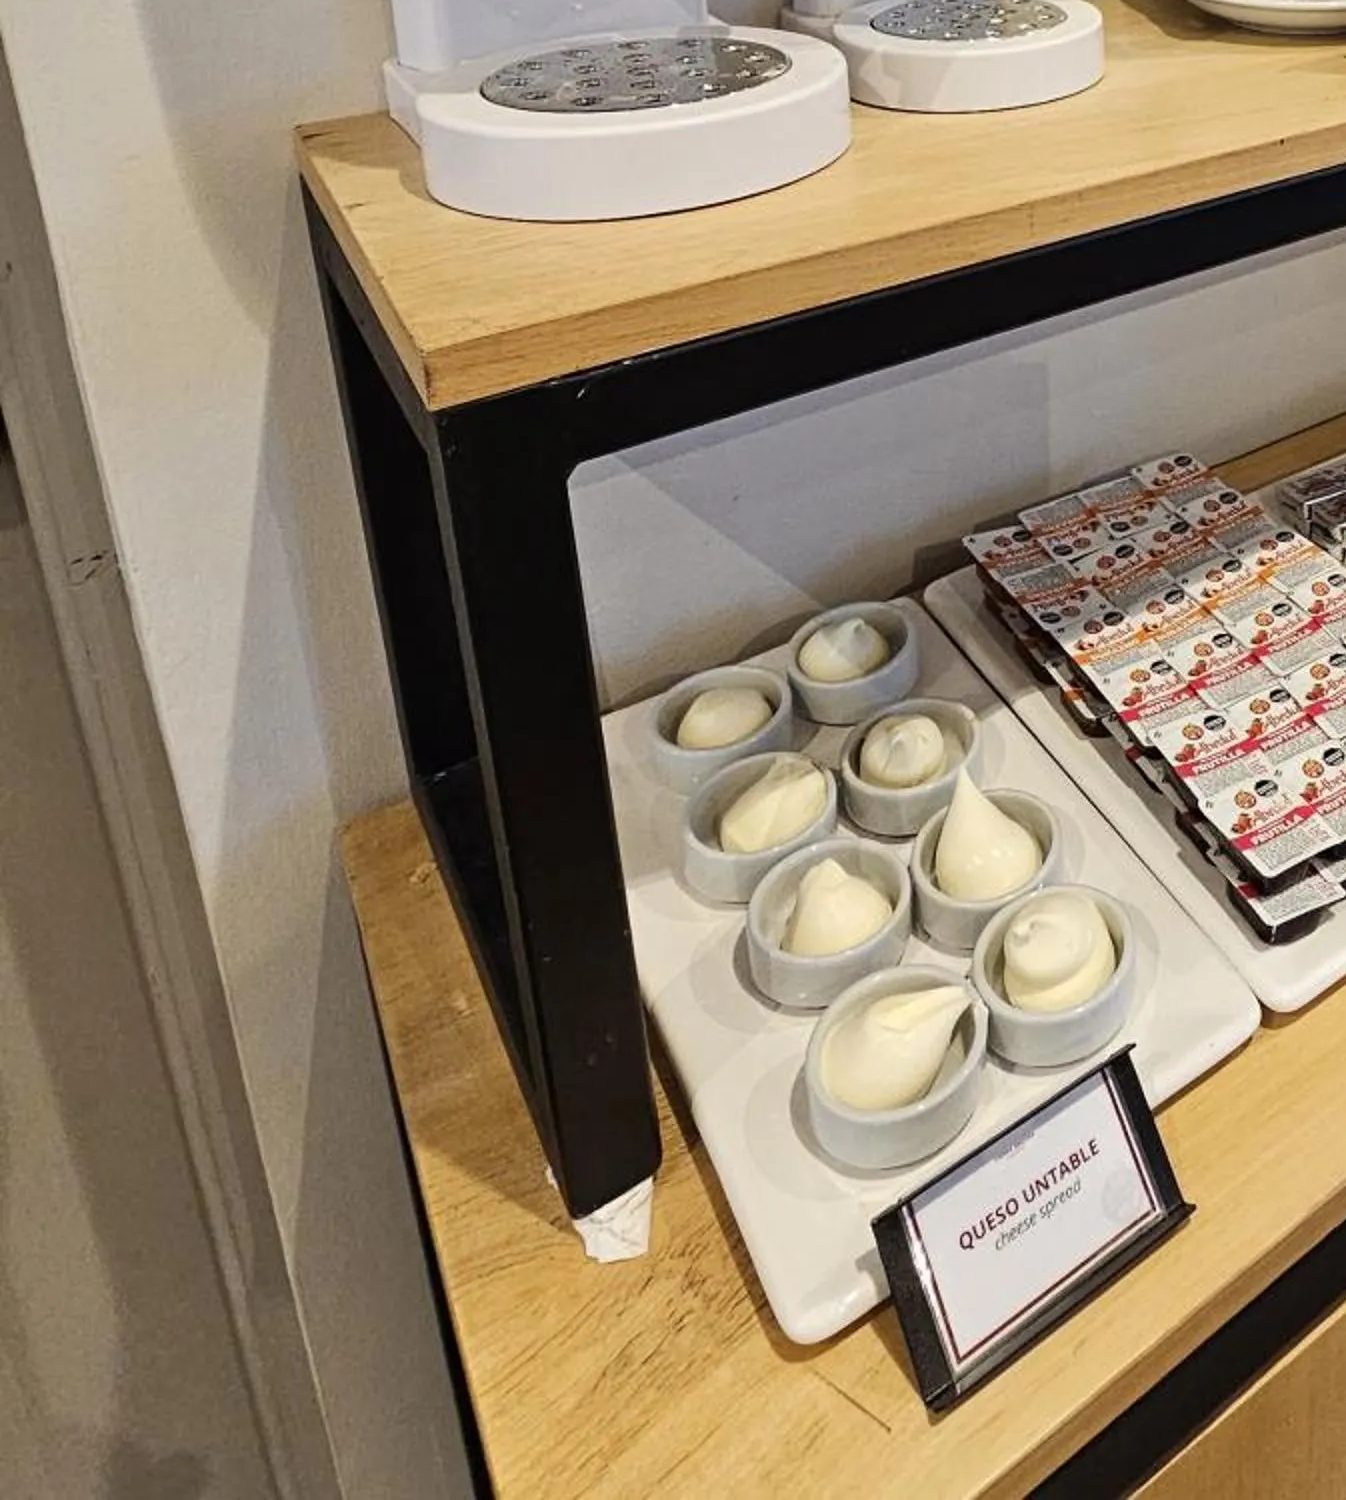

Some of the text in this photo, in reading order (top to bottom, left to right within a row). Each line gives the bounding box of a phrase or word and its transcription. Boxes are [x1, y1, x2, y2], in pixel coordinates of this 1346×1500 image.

[958, 1198, 1020, 1251] QUESO
[1021, 1138, 1101, 1205] UNTABLE
[994, 1180, 1083, 1251] cheese spread
